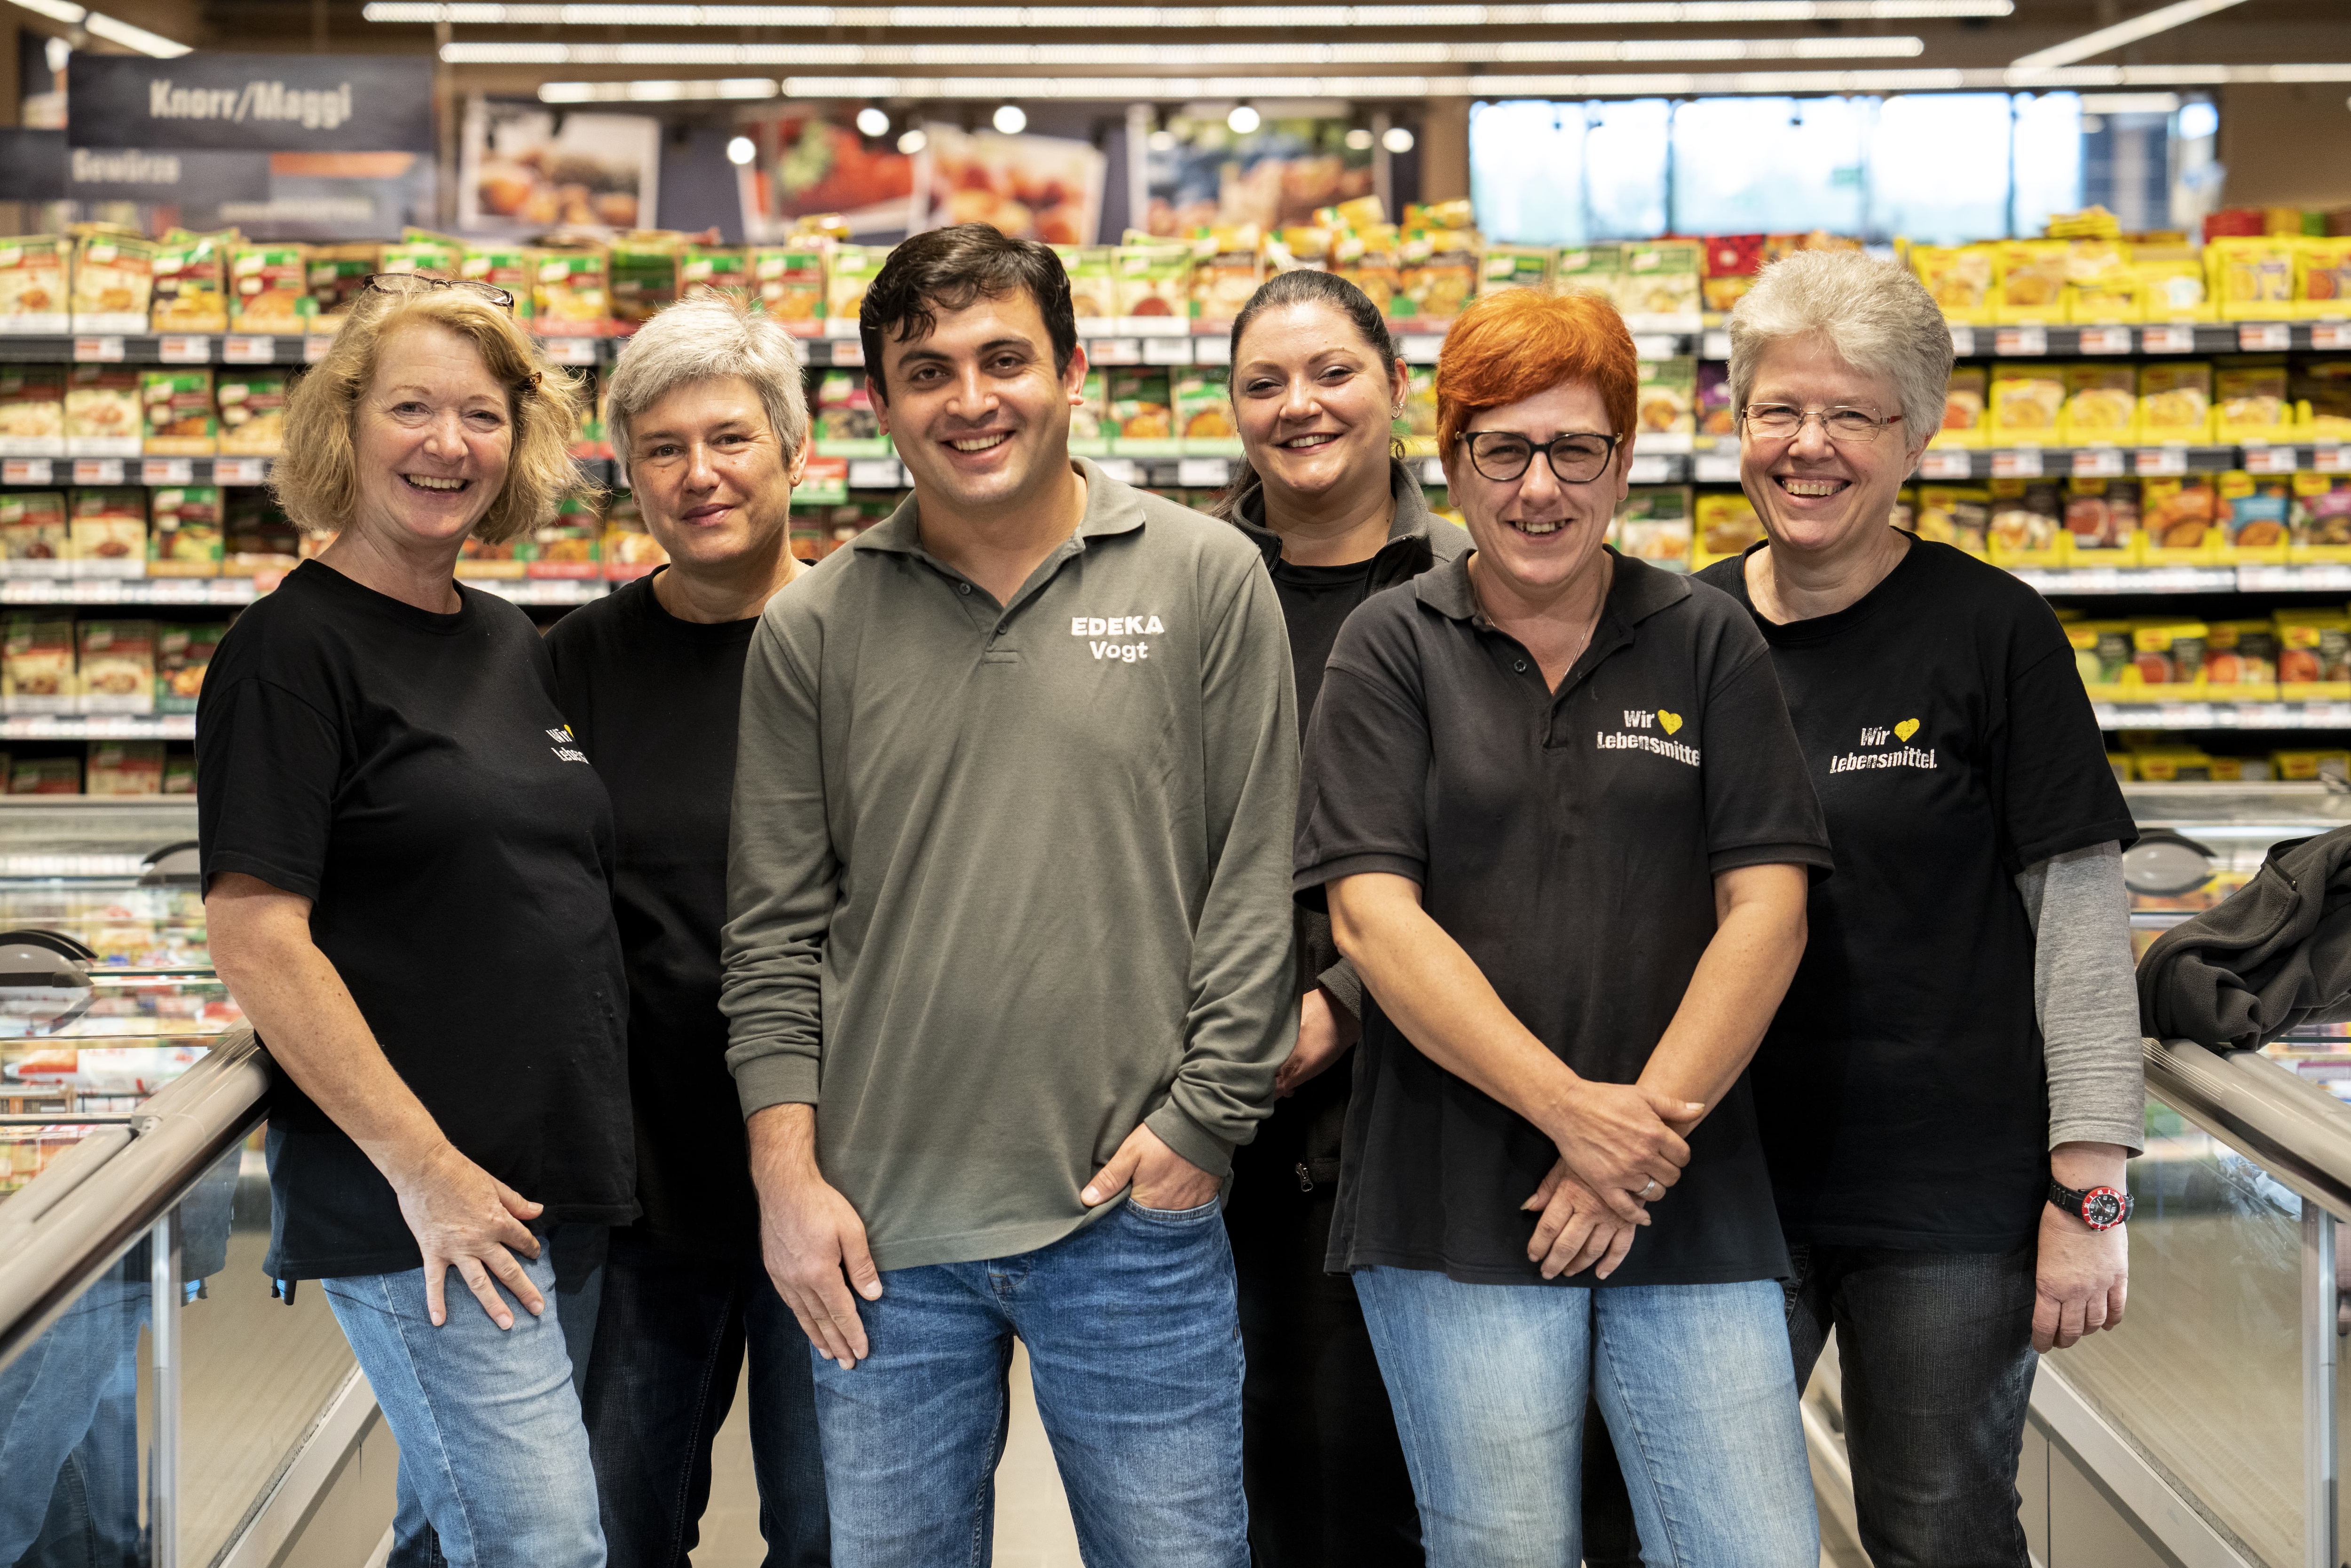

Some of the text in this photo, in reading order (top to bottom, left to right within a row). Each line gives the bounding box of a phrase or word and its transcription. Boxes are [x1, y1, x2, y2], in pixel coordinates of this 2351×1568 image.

[150, 79, 352, 129] Knorr/Maggi
[1071, 615, 1165, 636] EDEKA
[1089, 640, 1149, 663] Vogt
[1624, 710, 1655, 728] Wir
[545, 728, 573, 743] Wir
[1860, 726, 1891, 746] Wir
[1597, 731, 1701, 767] Lebensmitte
[1830, 746, 1938, 774] Lebensmittel.
